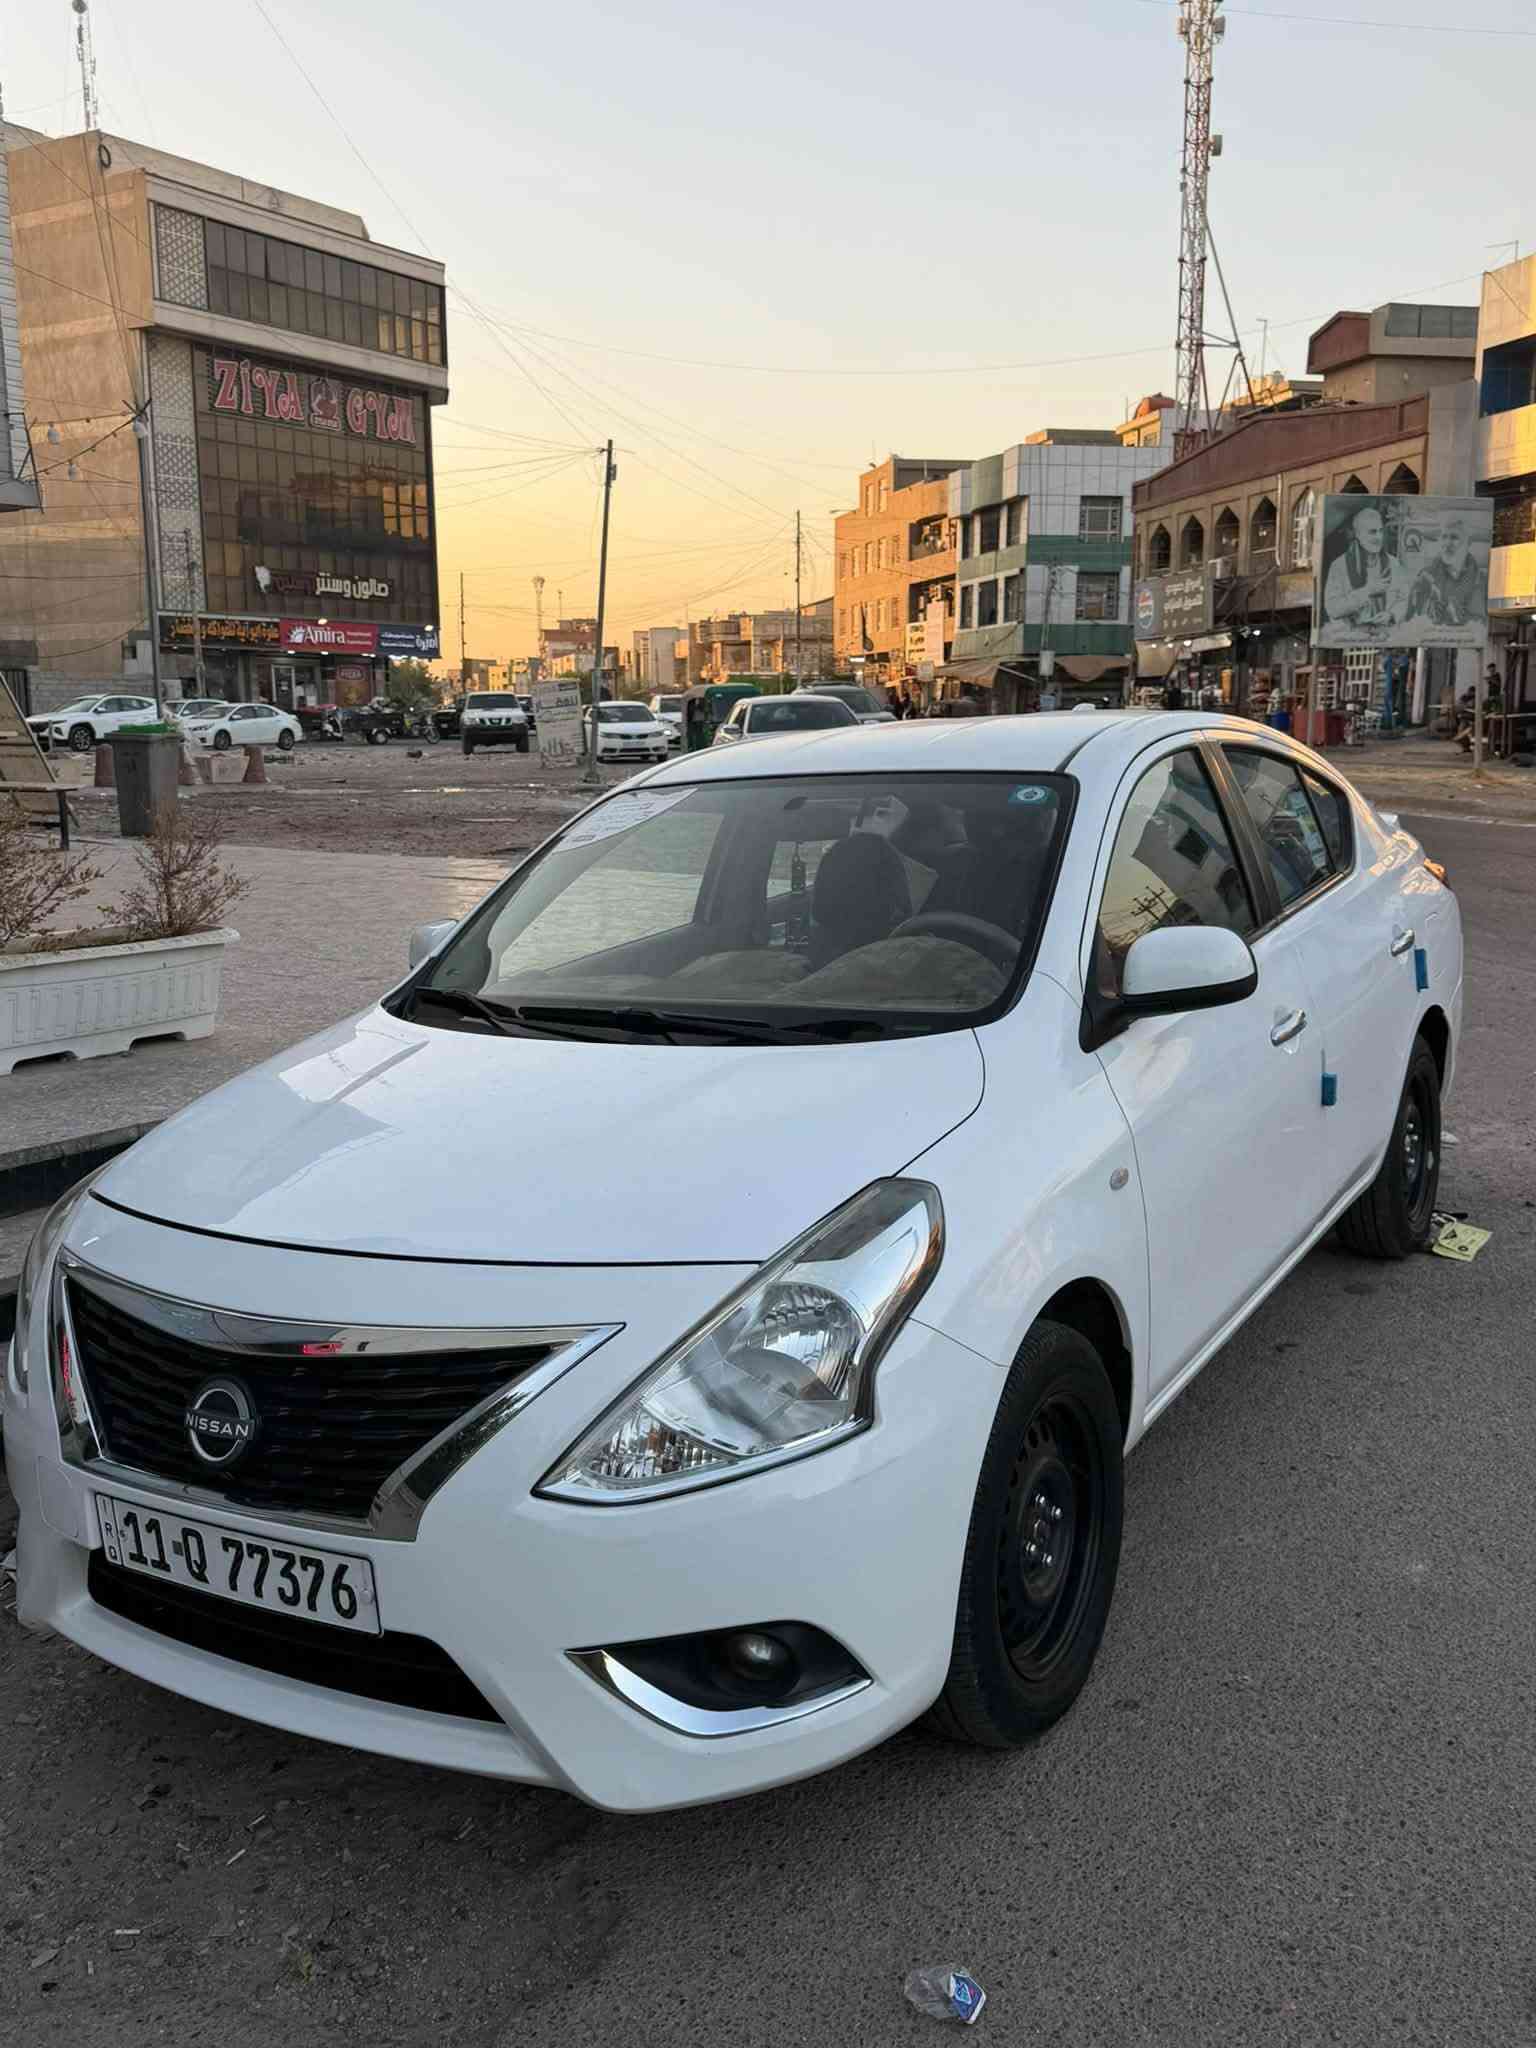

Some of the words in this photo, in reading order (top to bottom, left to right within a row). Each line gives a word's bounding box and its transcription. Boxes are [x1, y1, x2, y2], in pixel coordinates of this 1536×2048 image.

[346, 387, 416, 444] GYM
[352, 575, 389, 599] صالون
[304, 626, 345, 644] Amira
[185, 1412, 249, 1437] NISSAN
[220, 1536, 357, 1620] 77376
